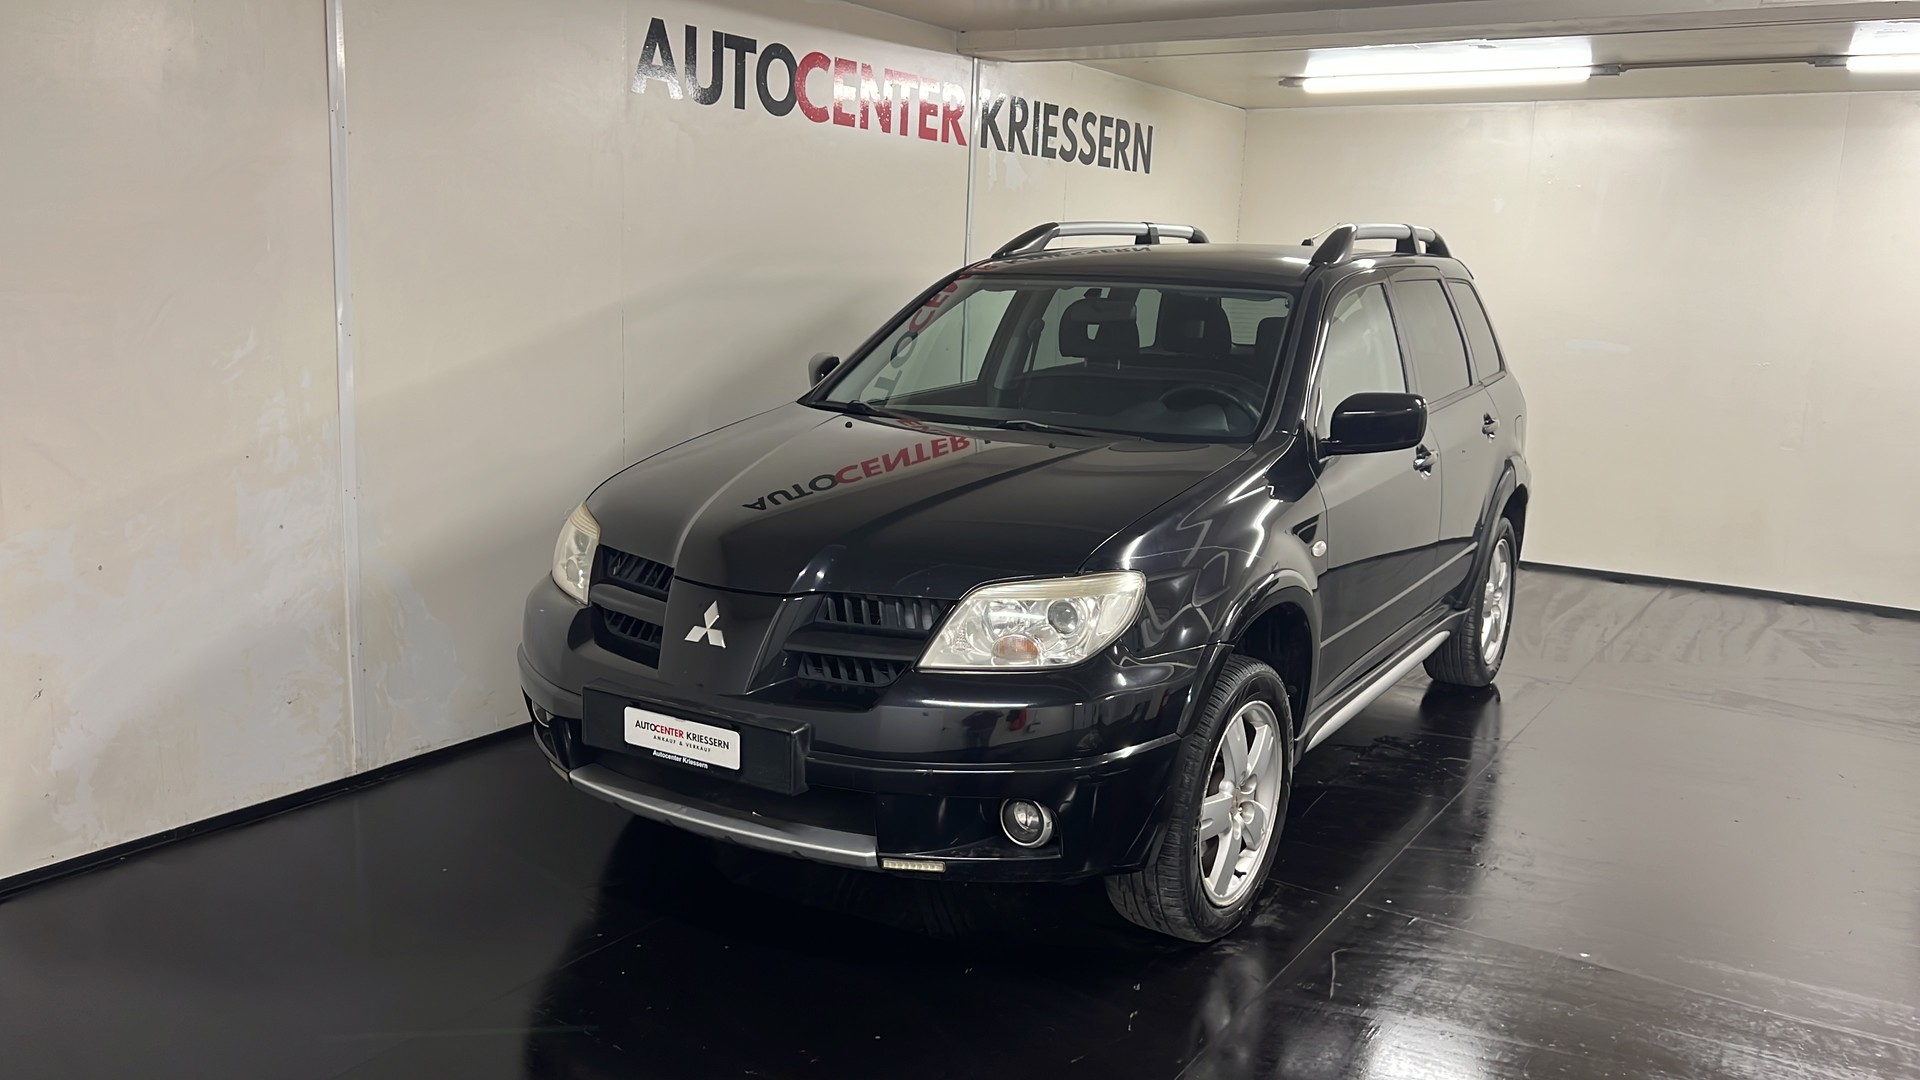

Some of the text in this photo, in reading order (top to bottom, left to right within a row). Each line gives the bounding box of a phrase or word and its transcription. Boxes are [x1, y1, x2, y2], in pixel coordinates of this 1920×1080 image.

[631, 17, 1154, 174] AUTOCENTER KRIESSERN
[635, 720, 729, 749] AUTOCENTER KRIESSERN
[653, 735, 676, 744] ANKAUF
[686, 743, 711, 752] VERKAUF
[652, 750, 709, 769] Autocenter Kriessern
